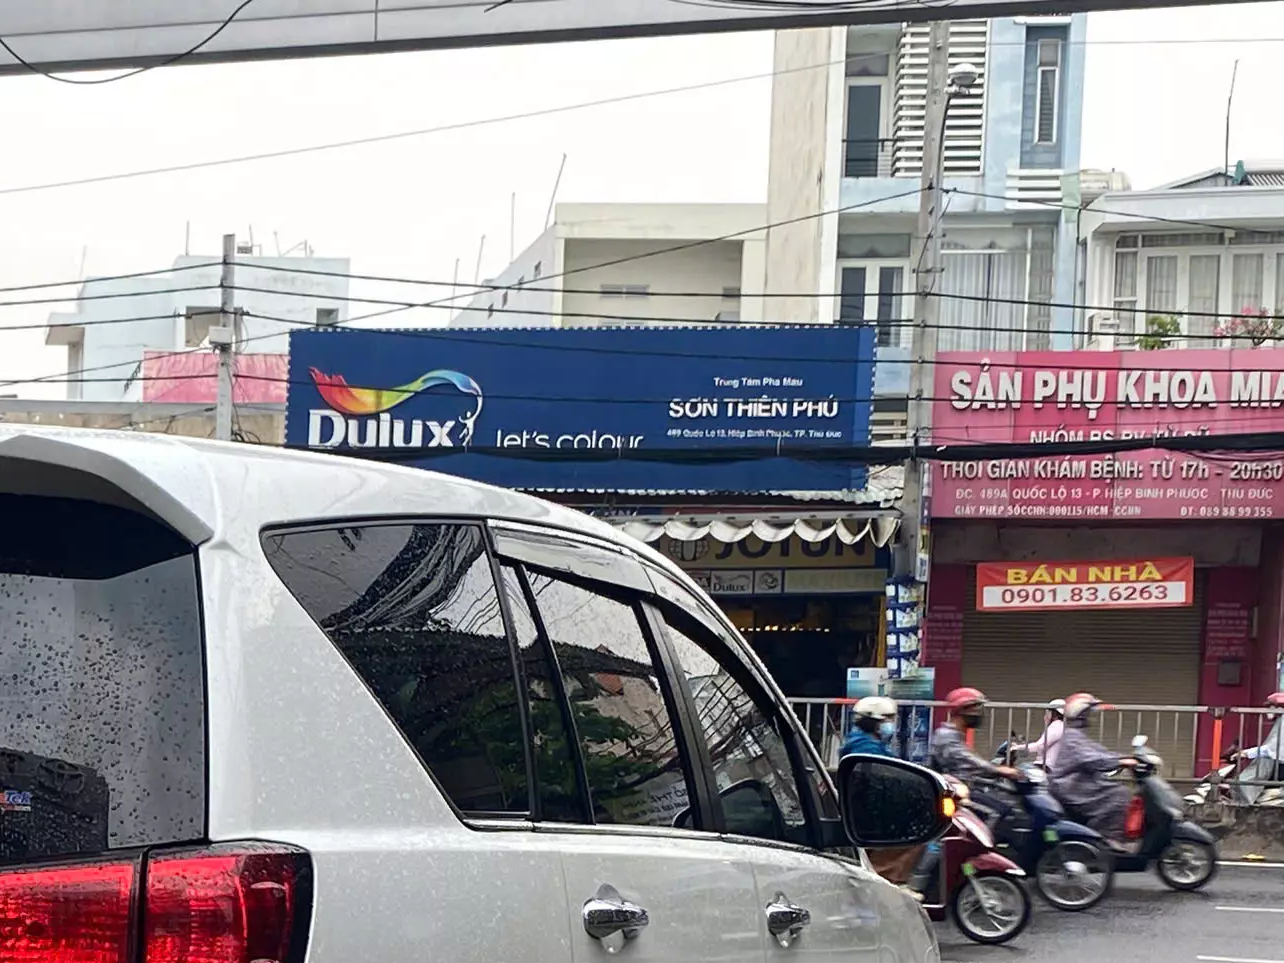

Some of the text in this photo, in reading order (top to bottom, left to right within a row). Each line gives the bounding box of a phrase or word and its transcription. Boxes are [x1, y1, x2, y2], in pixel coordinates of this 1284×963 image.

[951, 358, 1022, 410] SẢN
[1034, 371, 1107, 420] PHỤ
[1117, 371, 1217, 410] KHOA
[669, 394, 839, 418] SƠN THIÊN PHÚ
[308, 409, 456, 449] Dulux
[496, 429, 644, 449] let's colour
[1029, 424, 1084, 443] NHÓM
[986, 459, 1029, 479] GIAN
[1034, 456, 1086, 479] KHÁM
[1090, 455, 1144, 483] BỆNH:
[1149, 456, 1175, 479] TỪ
[1180, 460, 1210, 480] 17h
[1229, 461, 1284, 480] 20h30
[1012, 485, 1047, 499] QUỐC
[1050, 486, 1067, 501] LỘ
[1071, 488, 1082, 499] 13
[1007, 561, 1163, 585] BÁN NHÀ
[714, 582, 746, 592] Dulux
[1001, 585, 1169, 604] 0901.83.6263
